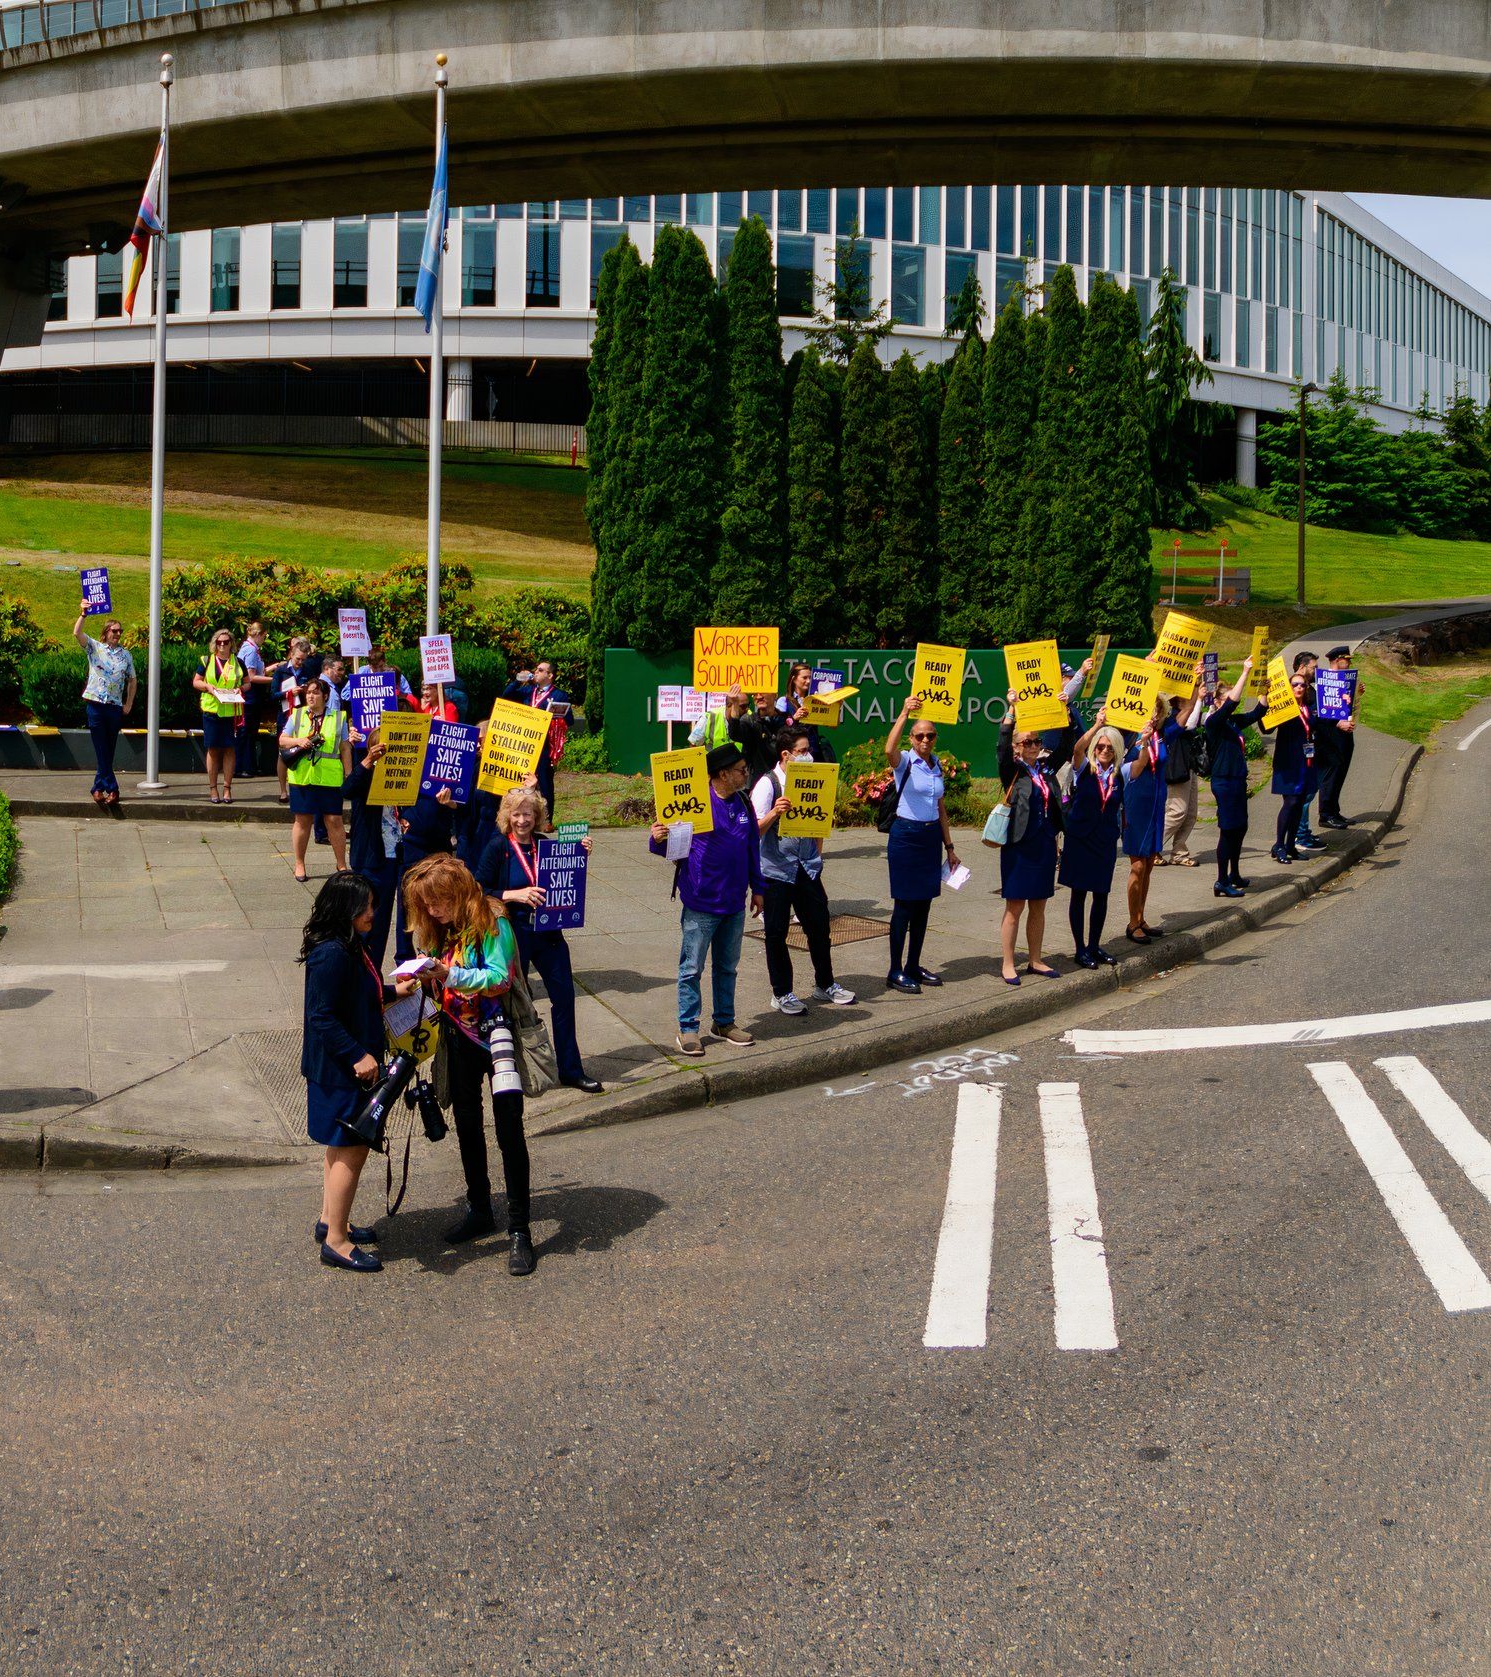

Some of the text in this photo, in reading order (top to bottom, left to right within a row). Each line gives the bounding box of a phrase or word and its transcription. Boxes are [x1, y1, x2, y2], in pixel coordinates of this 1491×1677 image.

[87, 570, 101, 578] FLIGHT
[89, 584, 103, 594] SAVE
[88, 593, 106, 603] LIVES!
[698, 630, 770, 656] WORKER
[1162, 630, 1206, 648] ALASKA QUIT
[1161, 642, 1199, 660] STALLING
[924, 661, 952, 674] READY
[1016, 658, 1041, 671] READY
[1157, 655, 1194, 670] OUR PAY IS
[697, 659, 777, 687] SOLIDARITY
[813, 671, 842, 682] CORPORATE
[1025, 672, 1041, 683] FOR
[1122, 671, 1149, 686] READY
[1323, 671, 1338, 680] FLIGHT
[360, 676, 384, 687] FLIGHT
[930, 676, 946, 686] FOR
[352, 686, 394, 698] ATTENDANTS
[916, 689, 955, 706] CHAOS
[1019, 683, 1054, 701] CHAOS
[1125, 685, 1142, 697] FOR
[1324, 686, 1340, 697] SAVE
[362, 699, 385, 713] SAVE
[1110, 698, 1148, 716] CHAOS
[409, 733, 422, 741] LIKE
[441, 724, 467, 738] FLIGHT
[492, 720, 543, 741] ALASKA QUIT
[428, 734, 475, 752] ATTENDANTS
[491, 734, 535, 755] STALLING
[436, 748, 462, 766] SAVE
[489, 750, 530, 768] OUR PAY IS
[430, 762, 462, 781] LIVES!
[664, 767, 694, 782] READY
[384, 781, 393, 789] DO
[673, 783, 691, 796] FOR
[794, 779, 824, 789] READY
[801, 793, 818, 802] FOR
[662, 797, 706, 819] CHAOS
[786, 805, 828, 822] CHAOS
[559, 824, 588, 834] UNION
[551, 843, 576, 856] FLIGHT
[540, 856, 585, 870] ATTENDANTS
[550, 871, 574, 888] SAVE
[546, 890, 576, 907] LIVES!
